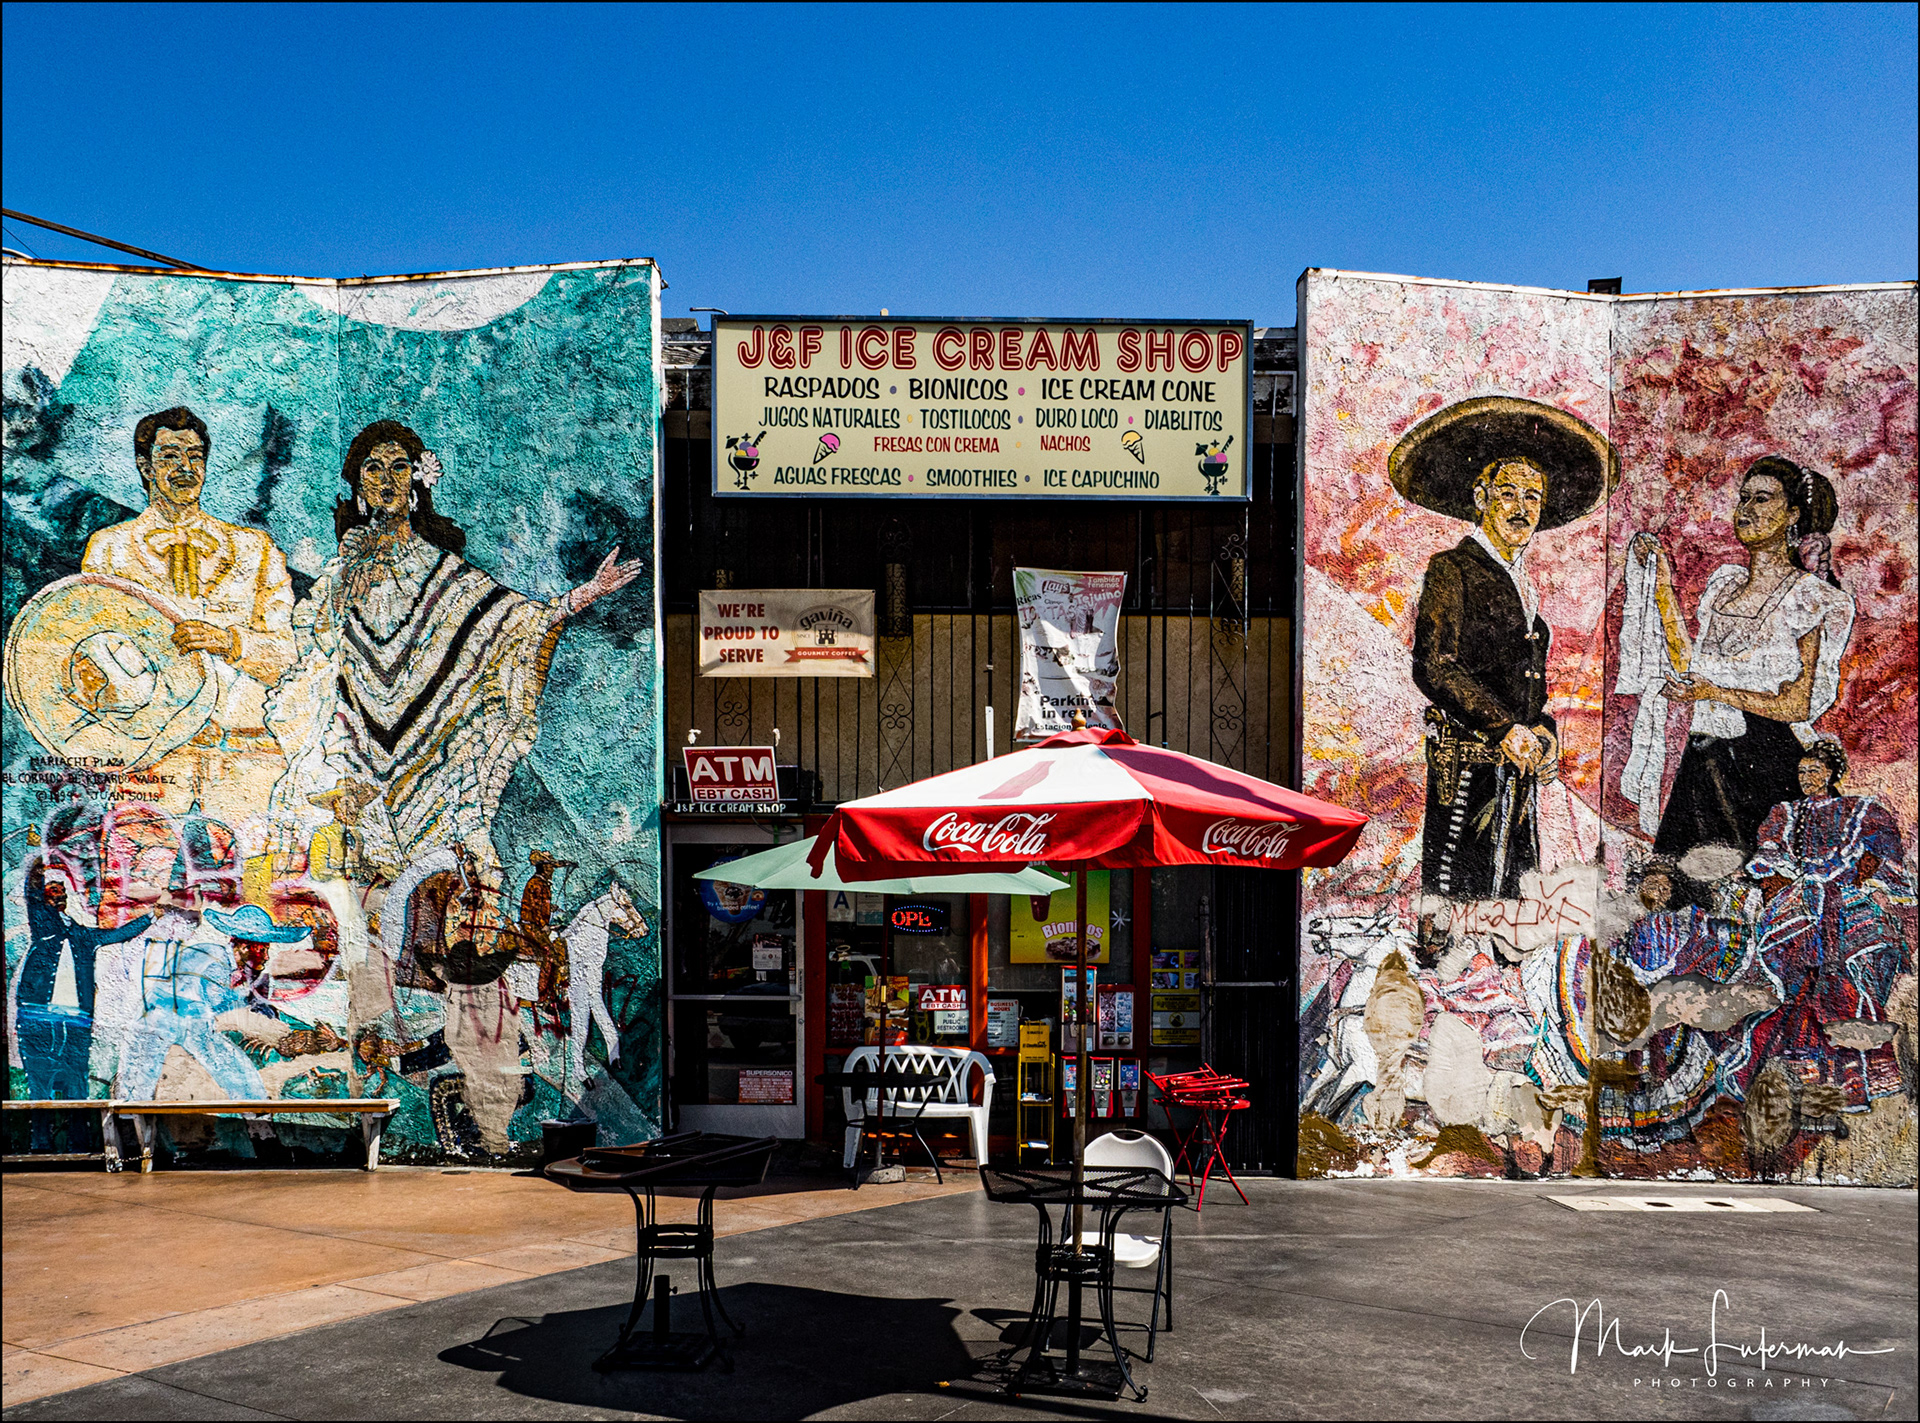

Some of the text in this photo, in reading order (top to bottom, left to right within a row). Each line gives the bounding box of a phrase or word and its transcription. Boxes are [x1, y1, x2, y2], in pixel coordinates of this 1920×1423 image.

[738, 324, 1243, 373] J&F ICE CREAM SHOP
[764, 376, 1216, 402] RASPADOS BIONICOS ICE CREAM CONE
[758, 406, 1222, 431] JUGOS NATURALES TOSTILOCOS DURO LOCO DIABLITOS
[874, 435, 1091, 453] FRESAS CON CREMA NACHOS
[773, 466, 1159, 488] AGUAS FRESCAS SMOOTHIES ICE CAPUCHINO
[1017, 594, 1042, 606] Ricas
[718, 603, 765, 618] WE'RE
[799, 608, 853, 631] gaviña
[704, 626, 780, 640] PROUD TO
[719, 648, 764, 662] SERVE
[1042, 707, 1056, 718] in
[30, 757, 126, 767] MARIACHI PLAZA
[692, 756, 774, 782] ATM
[133, 774, 176, 785] VALDEZ
[90, 790, 124, 801] JUAN
[128, 791, 161, 802] SOLIS
[696, 788, 773, 799] EBT CASH
[923, 812, 1058, 855] Coca-Cola
[1202, 817, 1305, 859] Coca-Cola
[1041, 919, 1104, 939] Bionios
[921, 988, 967, 1002] ATM
